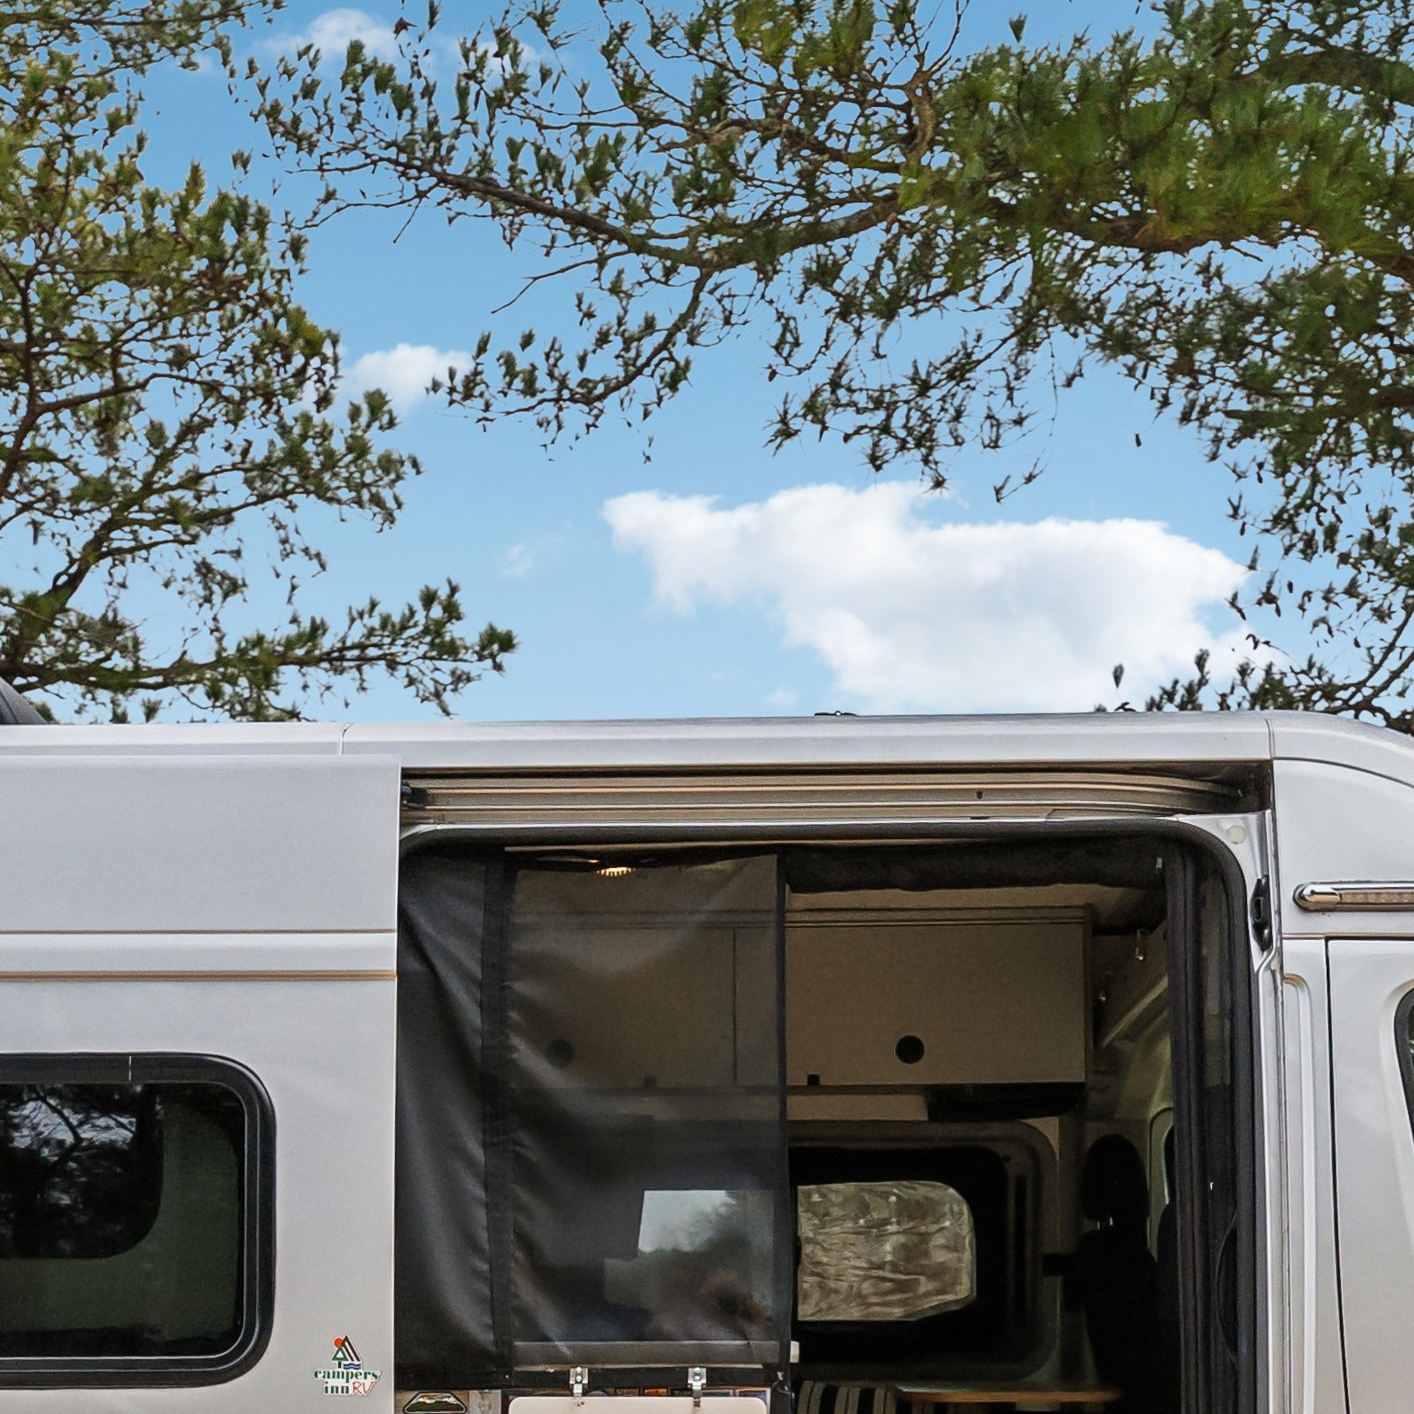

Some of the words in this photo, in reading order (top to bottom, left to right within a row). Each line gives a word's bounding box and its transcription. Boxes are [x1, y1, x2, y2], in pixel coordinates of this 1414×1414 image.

[314, 1370, 379, 1383] campers
[324, 1381, 350, 1394] inn
[352, 1381, 376, 1395] RV
